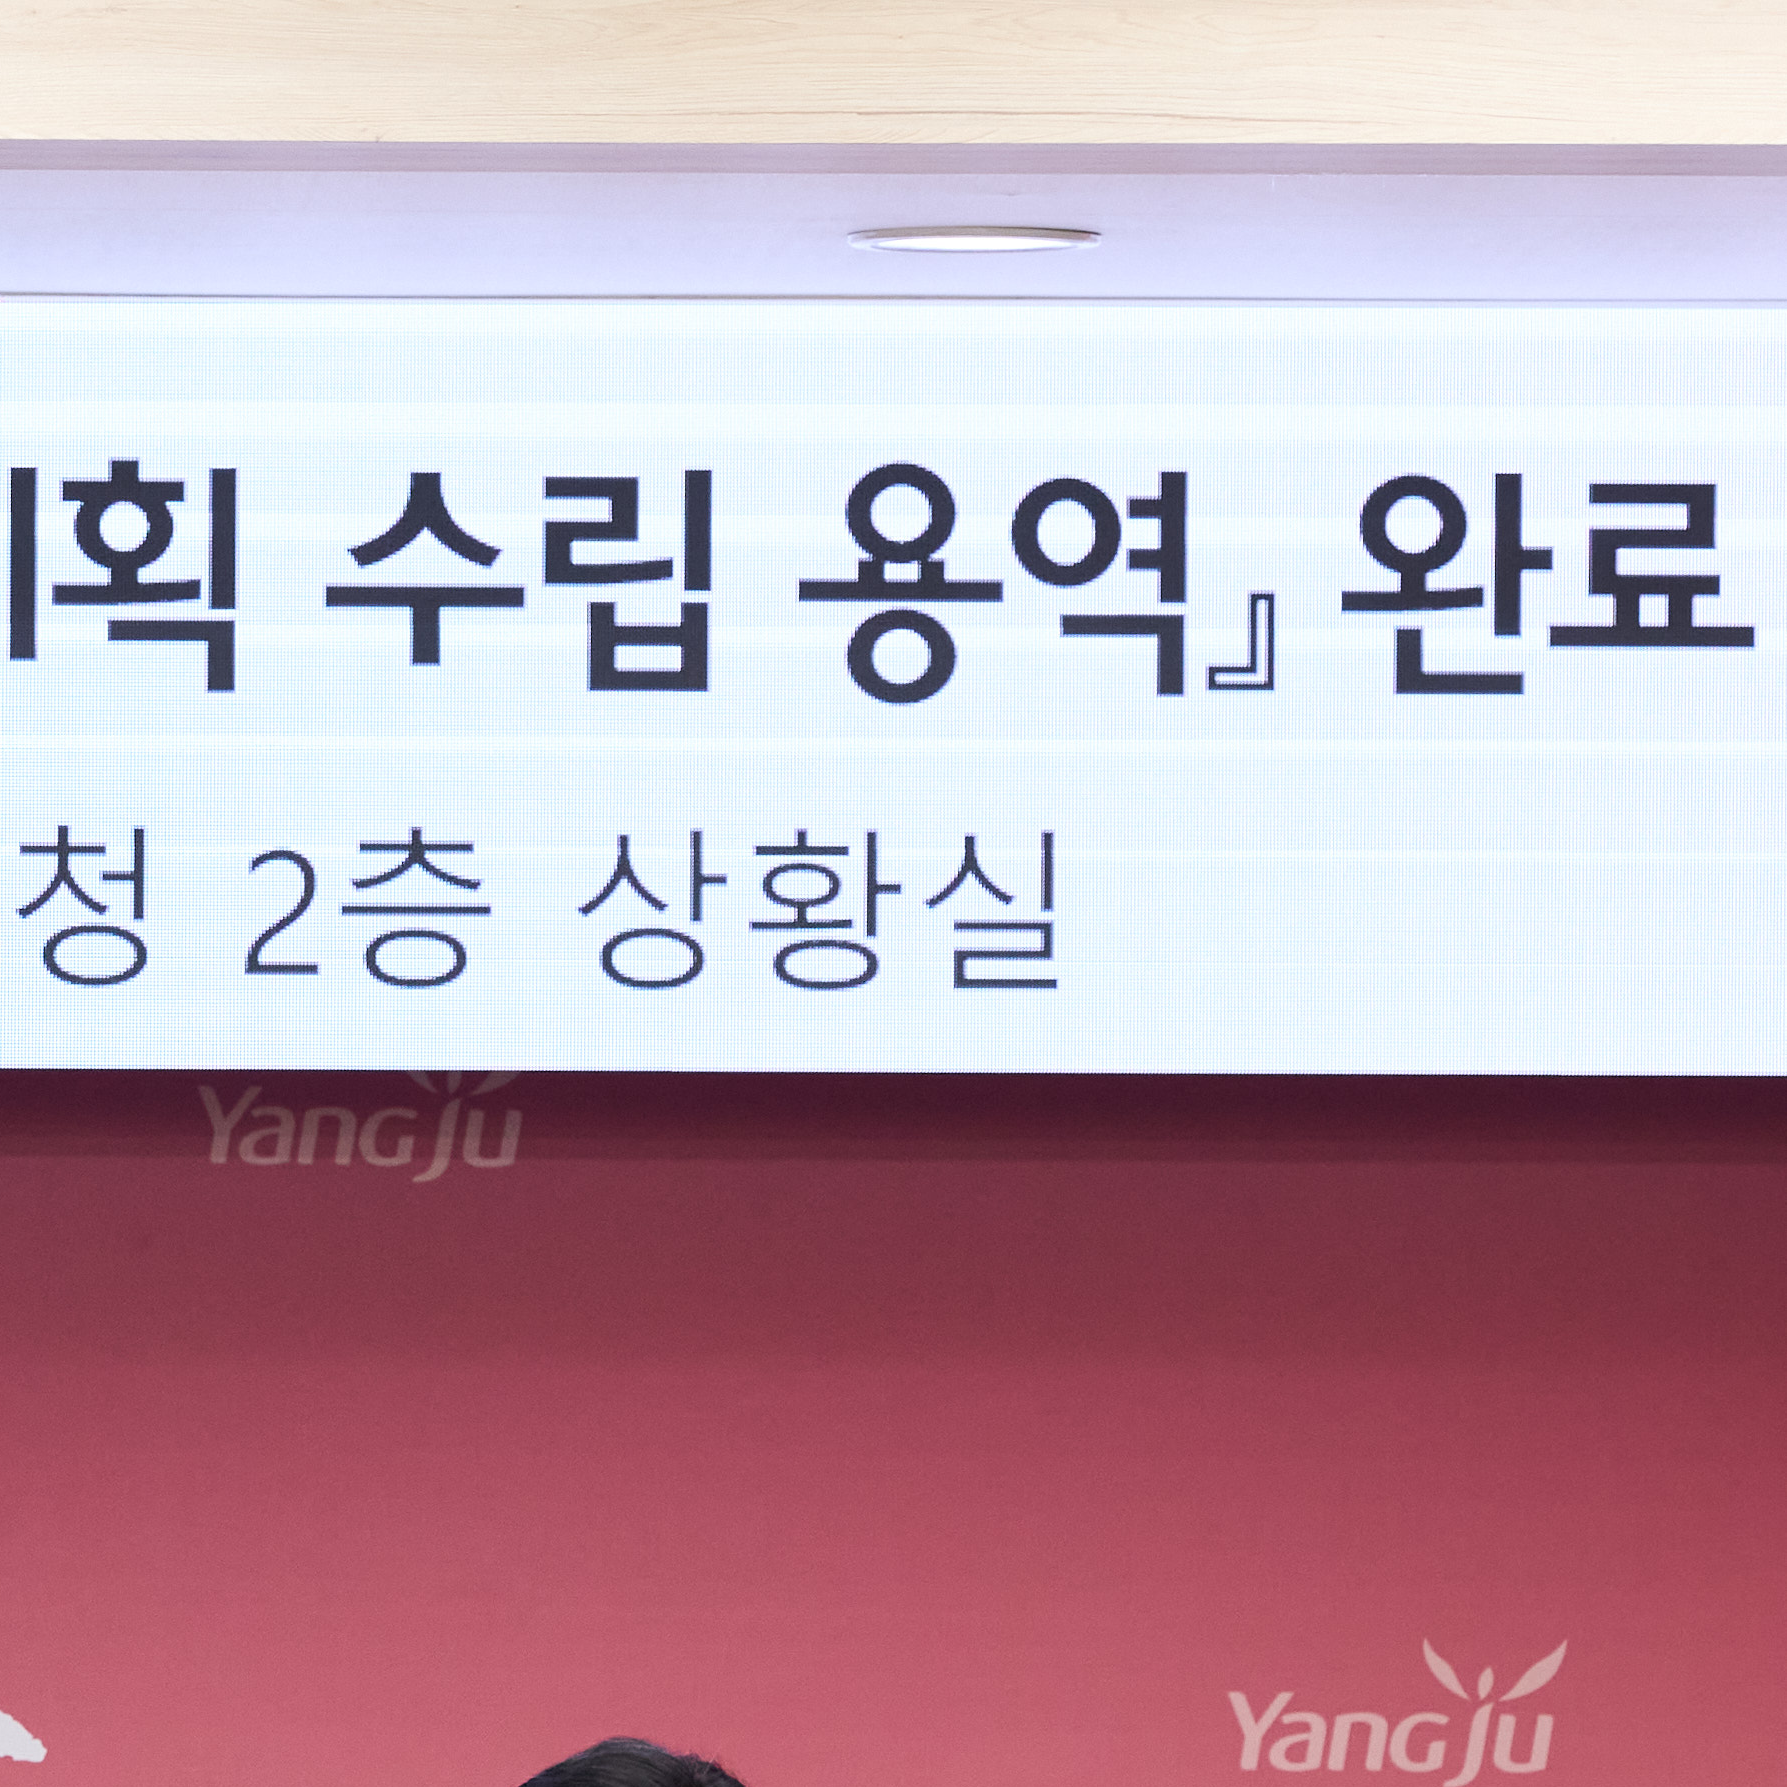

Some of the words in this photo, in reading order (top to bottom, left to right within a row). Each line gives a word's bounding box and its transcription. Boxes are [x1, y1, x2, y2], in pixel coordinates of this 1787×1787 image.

[324, 469, 712, 692] 수립
[797, 463, 1275, 704] 용역』
[1341, 473, 1755, 695] 완료
[245, 827, 490, 988] 2층
[580, 829, 1057, 990] 상황실
